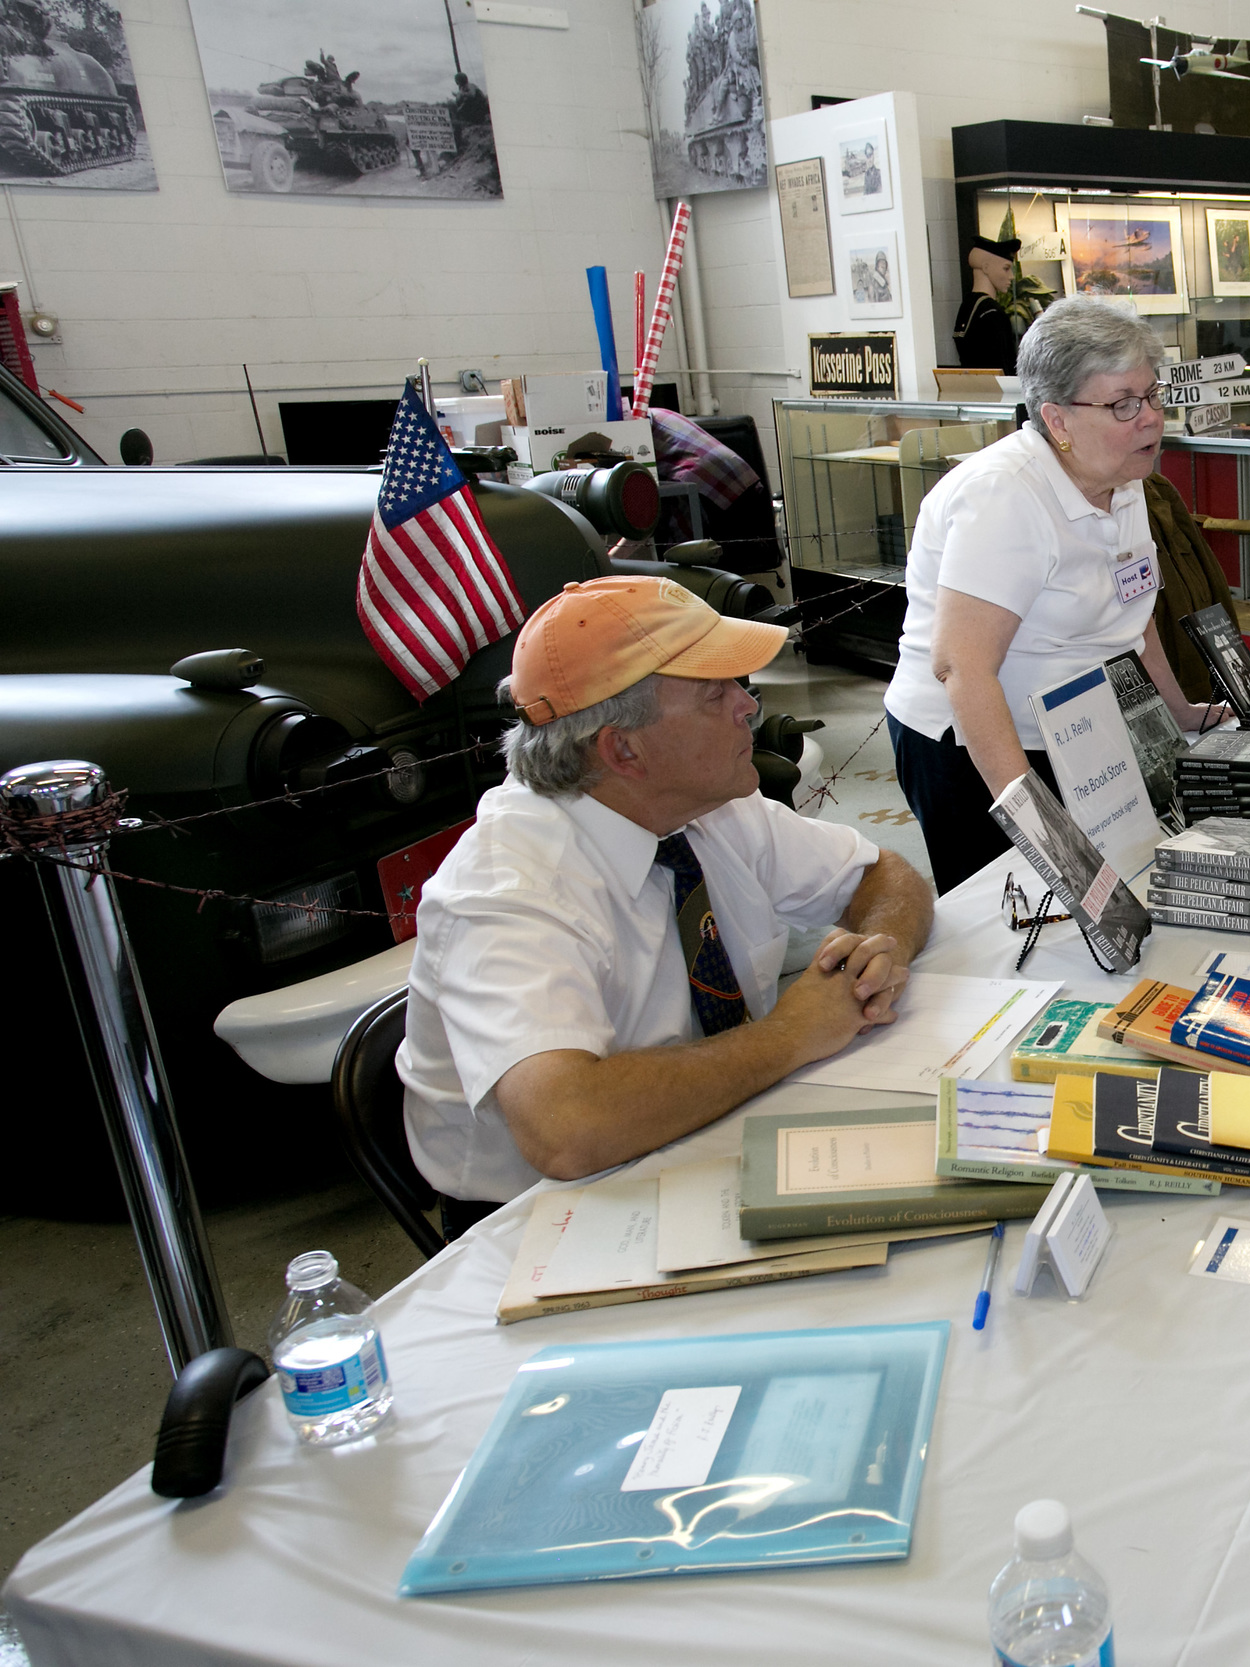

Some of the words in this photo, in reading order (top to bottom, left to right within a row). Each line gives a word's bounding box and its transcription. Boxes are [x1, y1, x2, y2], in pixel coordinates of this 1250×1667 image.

[813, 346, 862, 383] Kasserine
[865, 345, 892, 384] Pass
[1170, 363, 1203, 384] ROME
[1214, 363, 1223, 374] 23
[1224, 361, 1235, 372] KM
[1218, 387, 1229, 397] 12
[1233, 385, 1250, 396] KM
[1198, 415, 1204, 426] KM
[1205, 404, 1229, 426] CASSINO
[1121, 574, 1138, 586] Host
[1055, 732, 1065, 747] R.
[1065, 727, 1073, 742] J.
[1071, 716, 1093, 739] Reilly
[1073, 786, 1091, 802] The
[1088, 770, 1109, 794] Book
[1107, 760, 1128, 781] Store
[1087, 822, 1102, 839] Have
[1100, 814, 1114, 833] your
[1112, 804, 1126, 823] book
[1123, 795, 1139, 815] signed
[1096, 841, 1107, 852] ere.
[1012, 830, 1026, 850] THE
[1024, 846, 1050, 880] PELICAN
[1048, 877, 1076, 907] AFFAIR
[1181, 852, 1194, 863] THE
[1195, 853, 1227, 867] PELICAN
[1180, 863, 1193, 872] THE
[1194, 864, 1224, 877] PELICAN
[1224, 867, 1249, 881] AFFAIR
[1174, 876, 1188, 887] THE
[1188, 877, 1220, 892] PELICAN
[1221, 882, 1246, 897] AFFAIR
[1171, 893, 1185, 905] THE
[1186, 895, 1218, 910] PELICAN
[1218, 900, 1244, 913] AFFAIR
[1173, 911, 1187, 923] THE
[1187, 913, 1220, 928] PELICAN
[1221, 917, 1249, 930] AFFAIR
[1084, 923, 1093, 934] R.
[1095, 935, 1119, 961] REILLY
[1129, 1153, 1169, 1165] CHRISTIANITY
[1175, 1159, 1210, 1169] LITERATURE
[1190, 1148, 1230, 1161] CHRISTIANITY
[951, 1162, 990, 1175] Romantic
[991, 1166, 1025, 1179] Religion
[1030, 1170, 1055, 1179] Barfield
[1156, 1180, 1162, 1189] J.
[1164, 1181, 1193, 1189] REILLY
[1184, 1170, 1223, 1182] SOUTHERN
[827, 1214, 885, 1228] Evolution
[888, 1210, 902, 1223] of
[903, 1207, 988, 1223] Consciousness
[637, 1284, 687, 1299] Thought
[542, 1304, 570, 1315] SPRING
[572, 1300, 590, 1311] 1963
